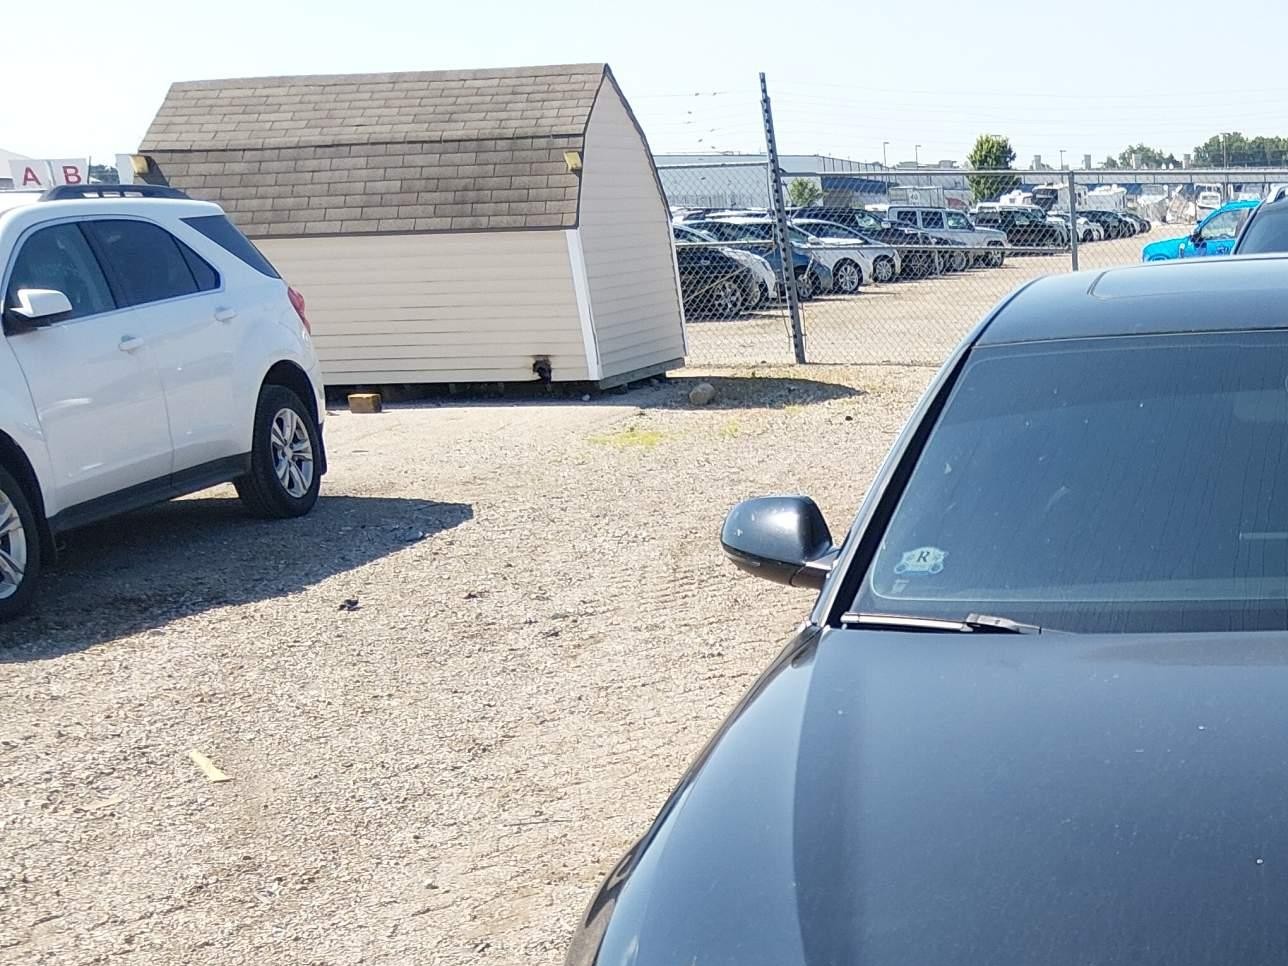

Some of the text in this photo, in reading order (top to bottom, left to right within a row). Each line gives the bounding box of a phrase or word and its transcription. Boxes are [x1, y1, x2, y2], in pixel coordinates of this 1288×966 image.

[23, 165, 82, 185] A B
[916, 551, 930, 562] R
